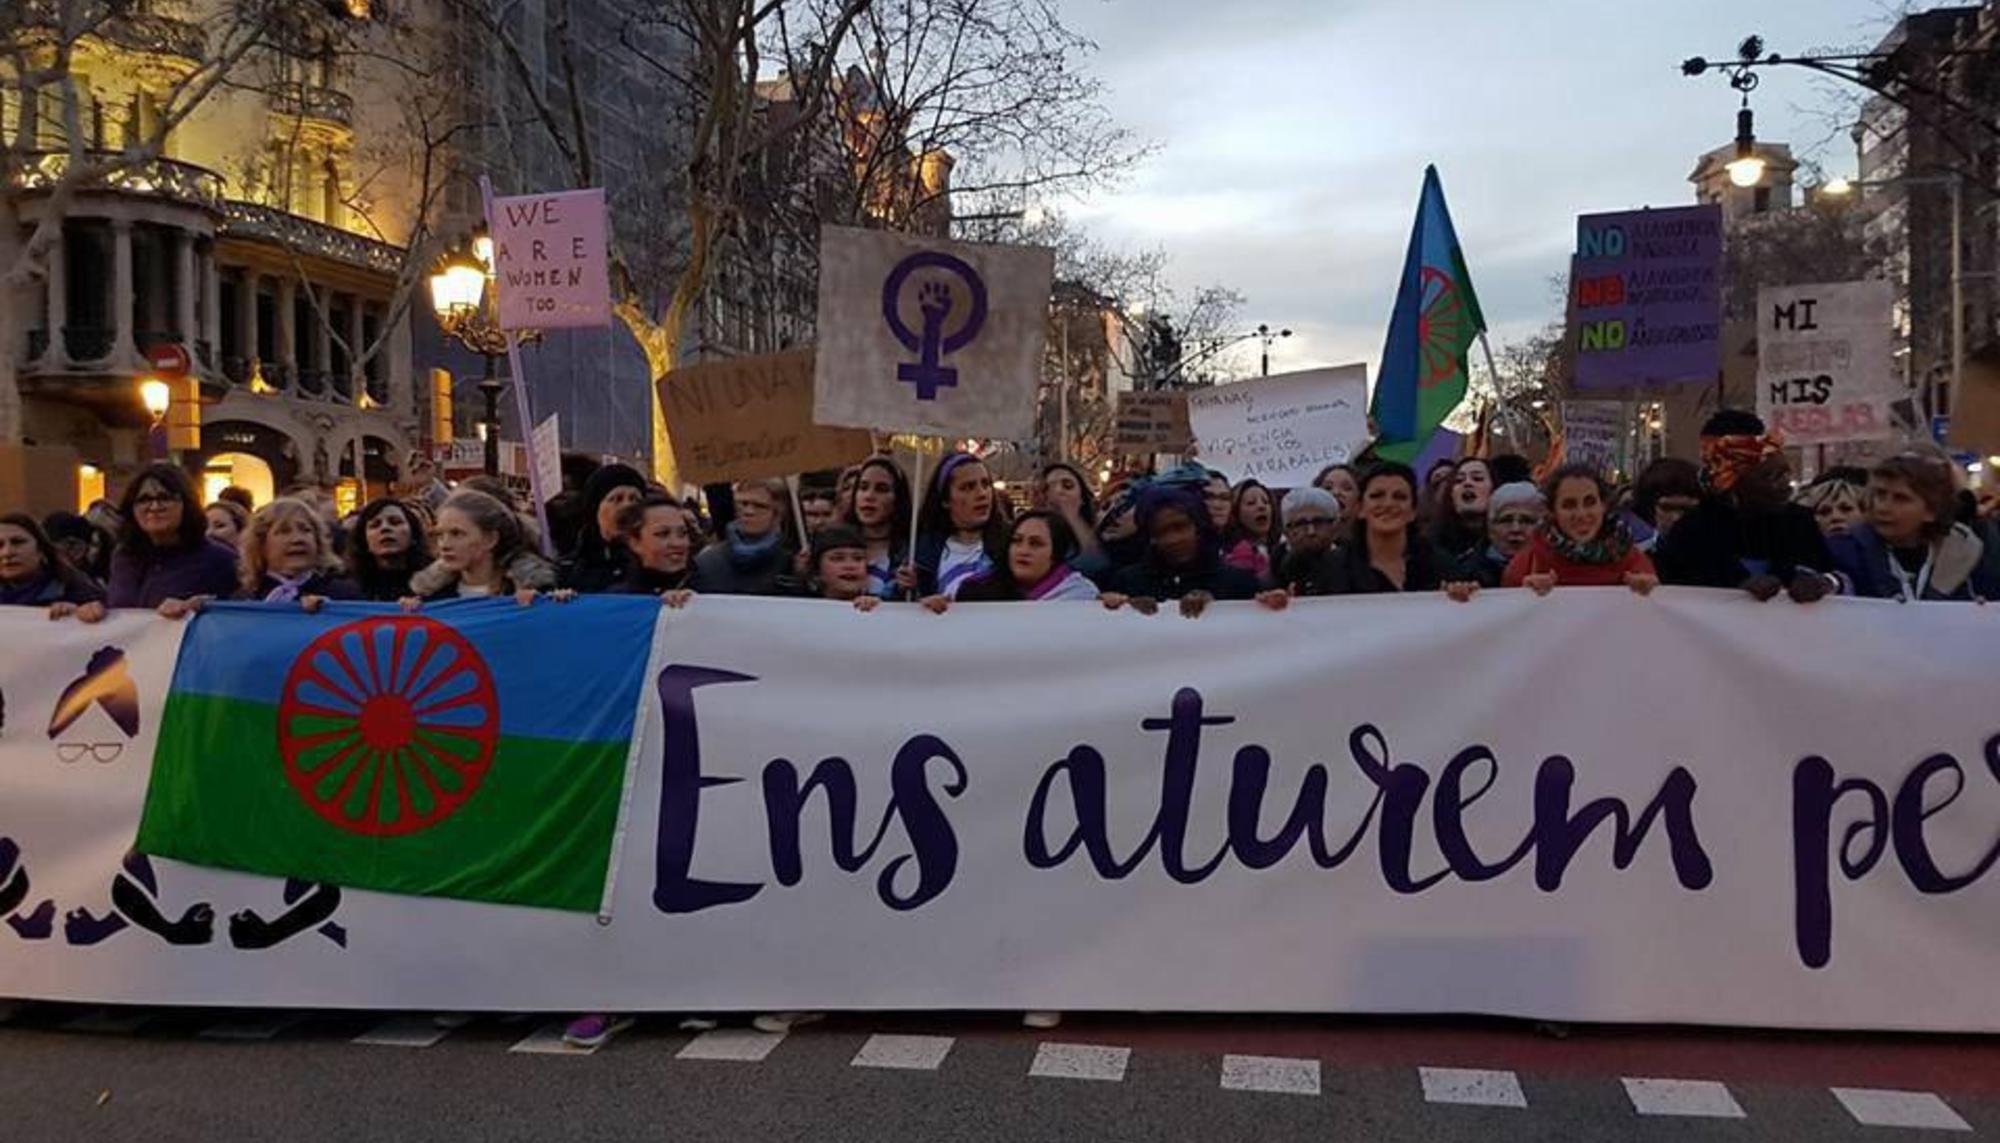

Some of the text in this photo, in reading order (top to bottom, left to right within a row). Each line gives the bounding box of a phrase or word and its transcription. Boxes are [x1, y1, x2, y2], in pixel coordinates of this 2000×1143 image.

[506, 200, 560, 228] WE
[1578, 224, 1627, 261] NO
[506, 266, 582, 288] WOMEN
[526, 297, 557, 312] TOO
[1773, 299, 1818, 331] MI
[1579, 319, 1627, 352] NO
[1769, 374, 1834, 405] MIS
[652, 663, 2000, 970] Ens aturem pe
